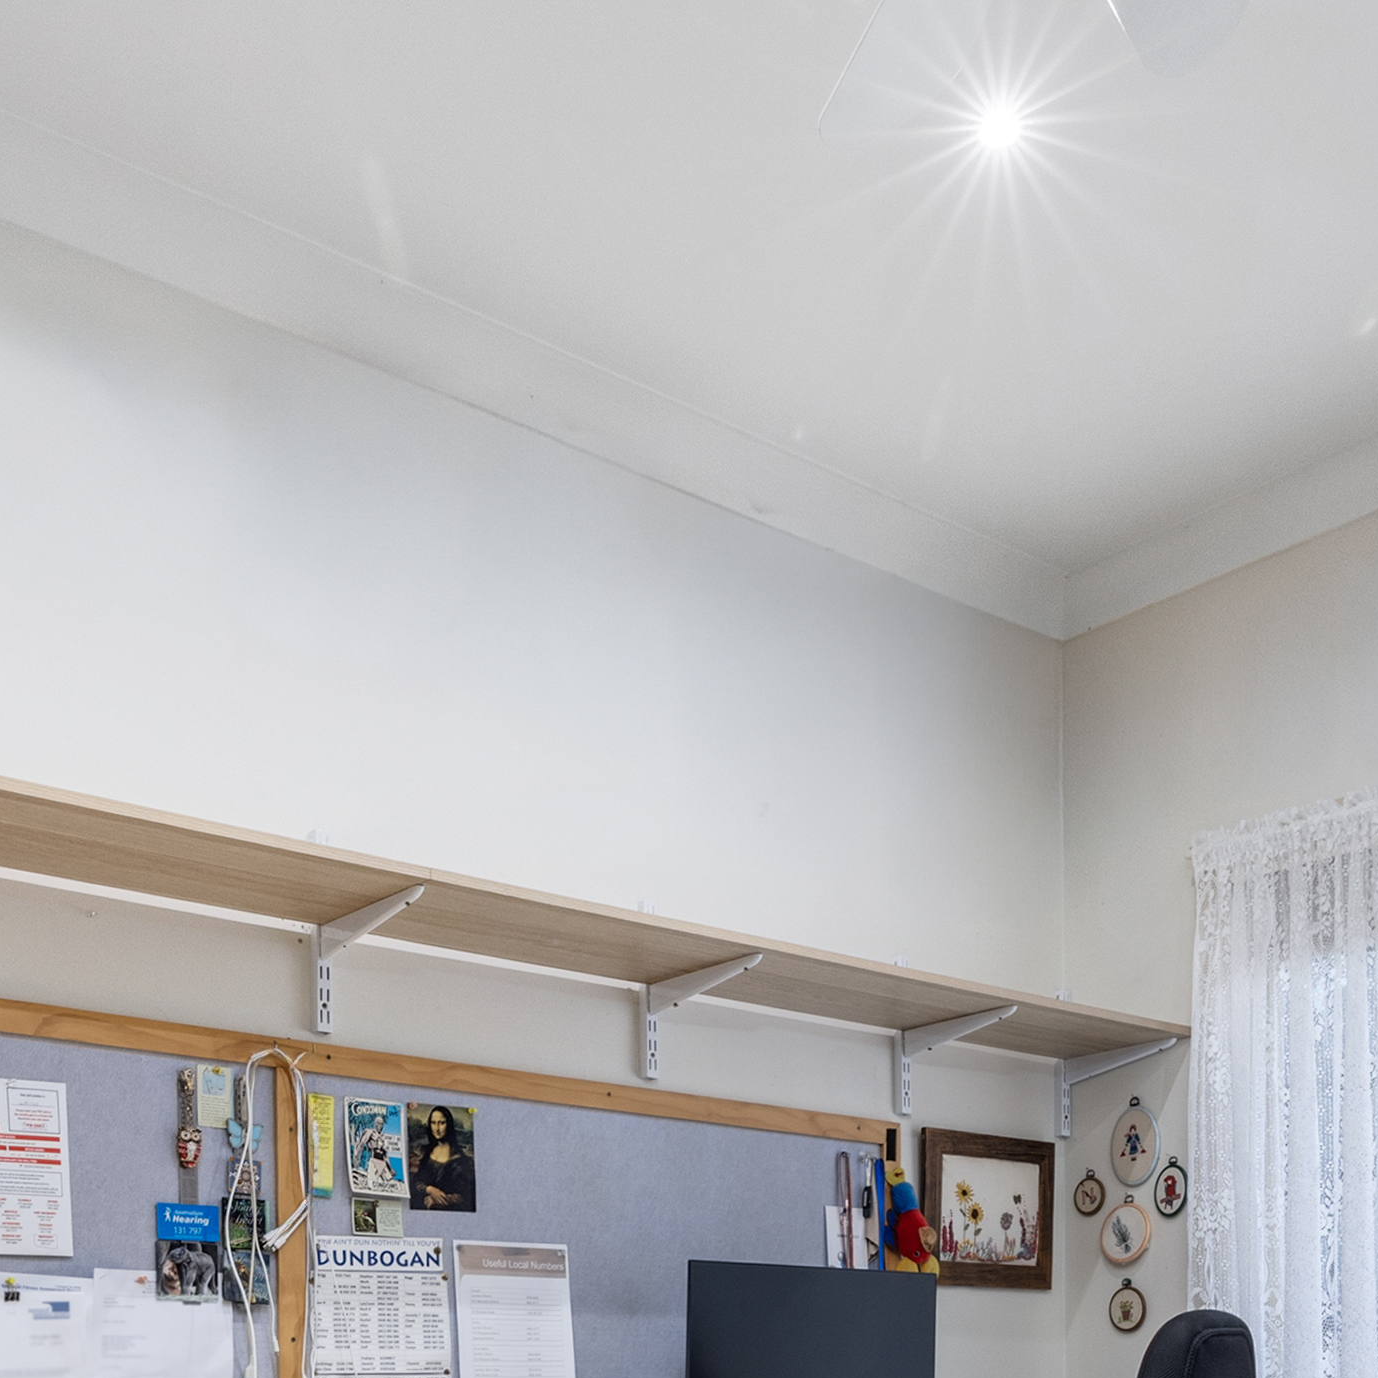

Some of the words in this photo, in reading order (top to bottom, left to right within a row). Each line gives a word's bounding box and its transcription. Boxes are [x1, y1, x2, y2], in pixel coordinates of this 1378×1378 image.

[173, 1215, 209, 1226] Hearing
[317, 1250, 440, 1267] DUNBOGAN
[483, 1259, 506, 1267] Useful
[508, 1260, 528, 1269] Local
[530, 1261, 564, 1271] Numbers
